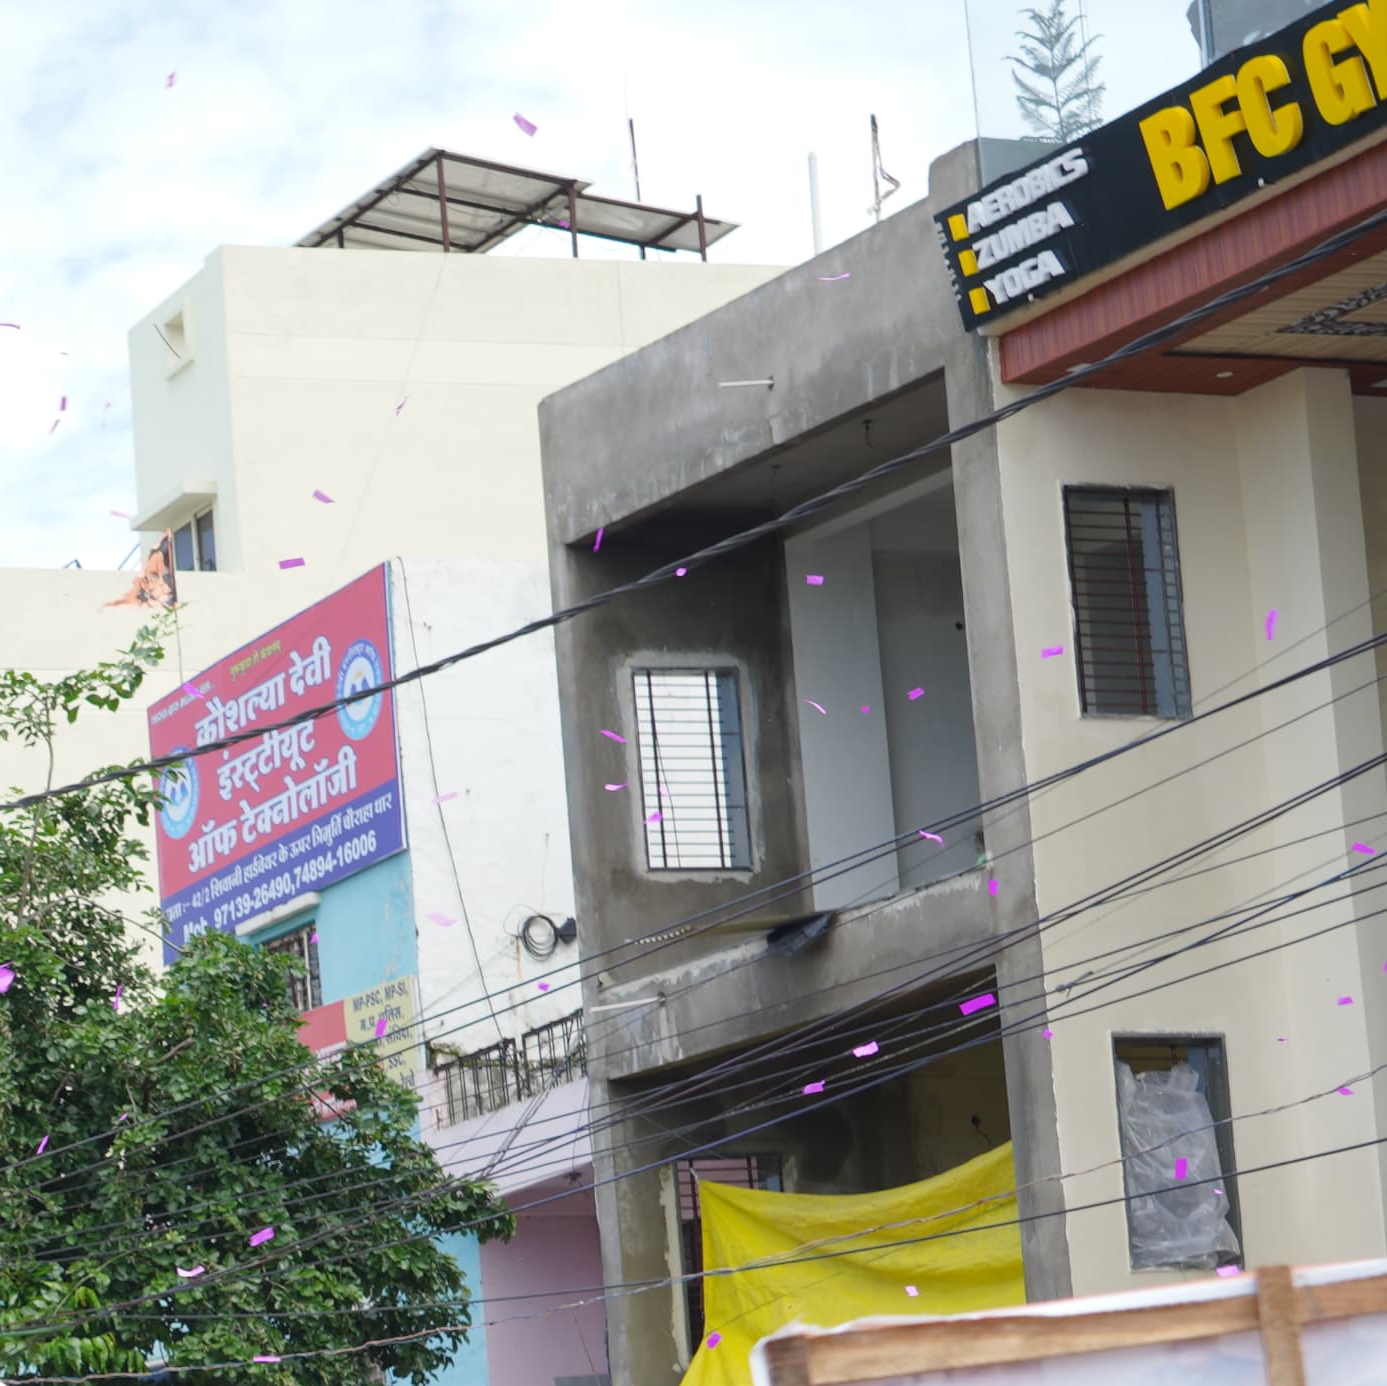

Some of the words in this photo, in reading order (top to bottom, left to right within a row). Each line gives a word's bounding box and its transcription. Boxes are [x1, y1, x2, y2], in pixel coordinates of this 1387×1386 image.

[1138, 54, 1304, 211] BFC
[967, 147, 1089, 235] AEROBICS
[971, 201, 1075, 270] ZUMBA
[983, 249, 1066, 305] YOGA
[195, 672, 286, 747] कौशल्या
[289, 635, 331, 697] देवी
[187, 819, 238, 873] ऑफ
[239, 745, 357, 844] टेक्नोलॉजी
[210, 864, 243, 900] शिवानी
[278, 843, 289, 863] के
[289, 835, 311, 858] ऊपर
[374, 792, 392, 814] धार
